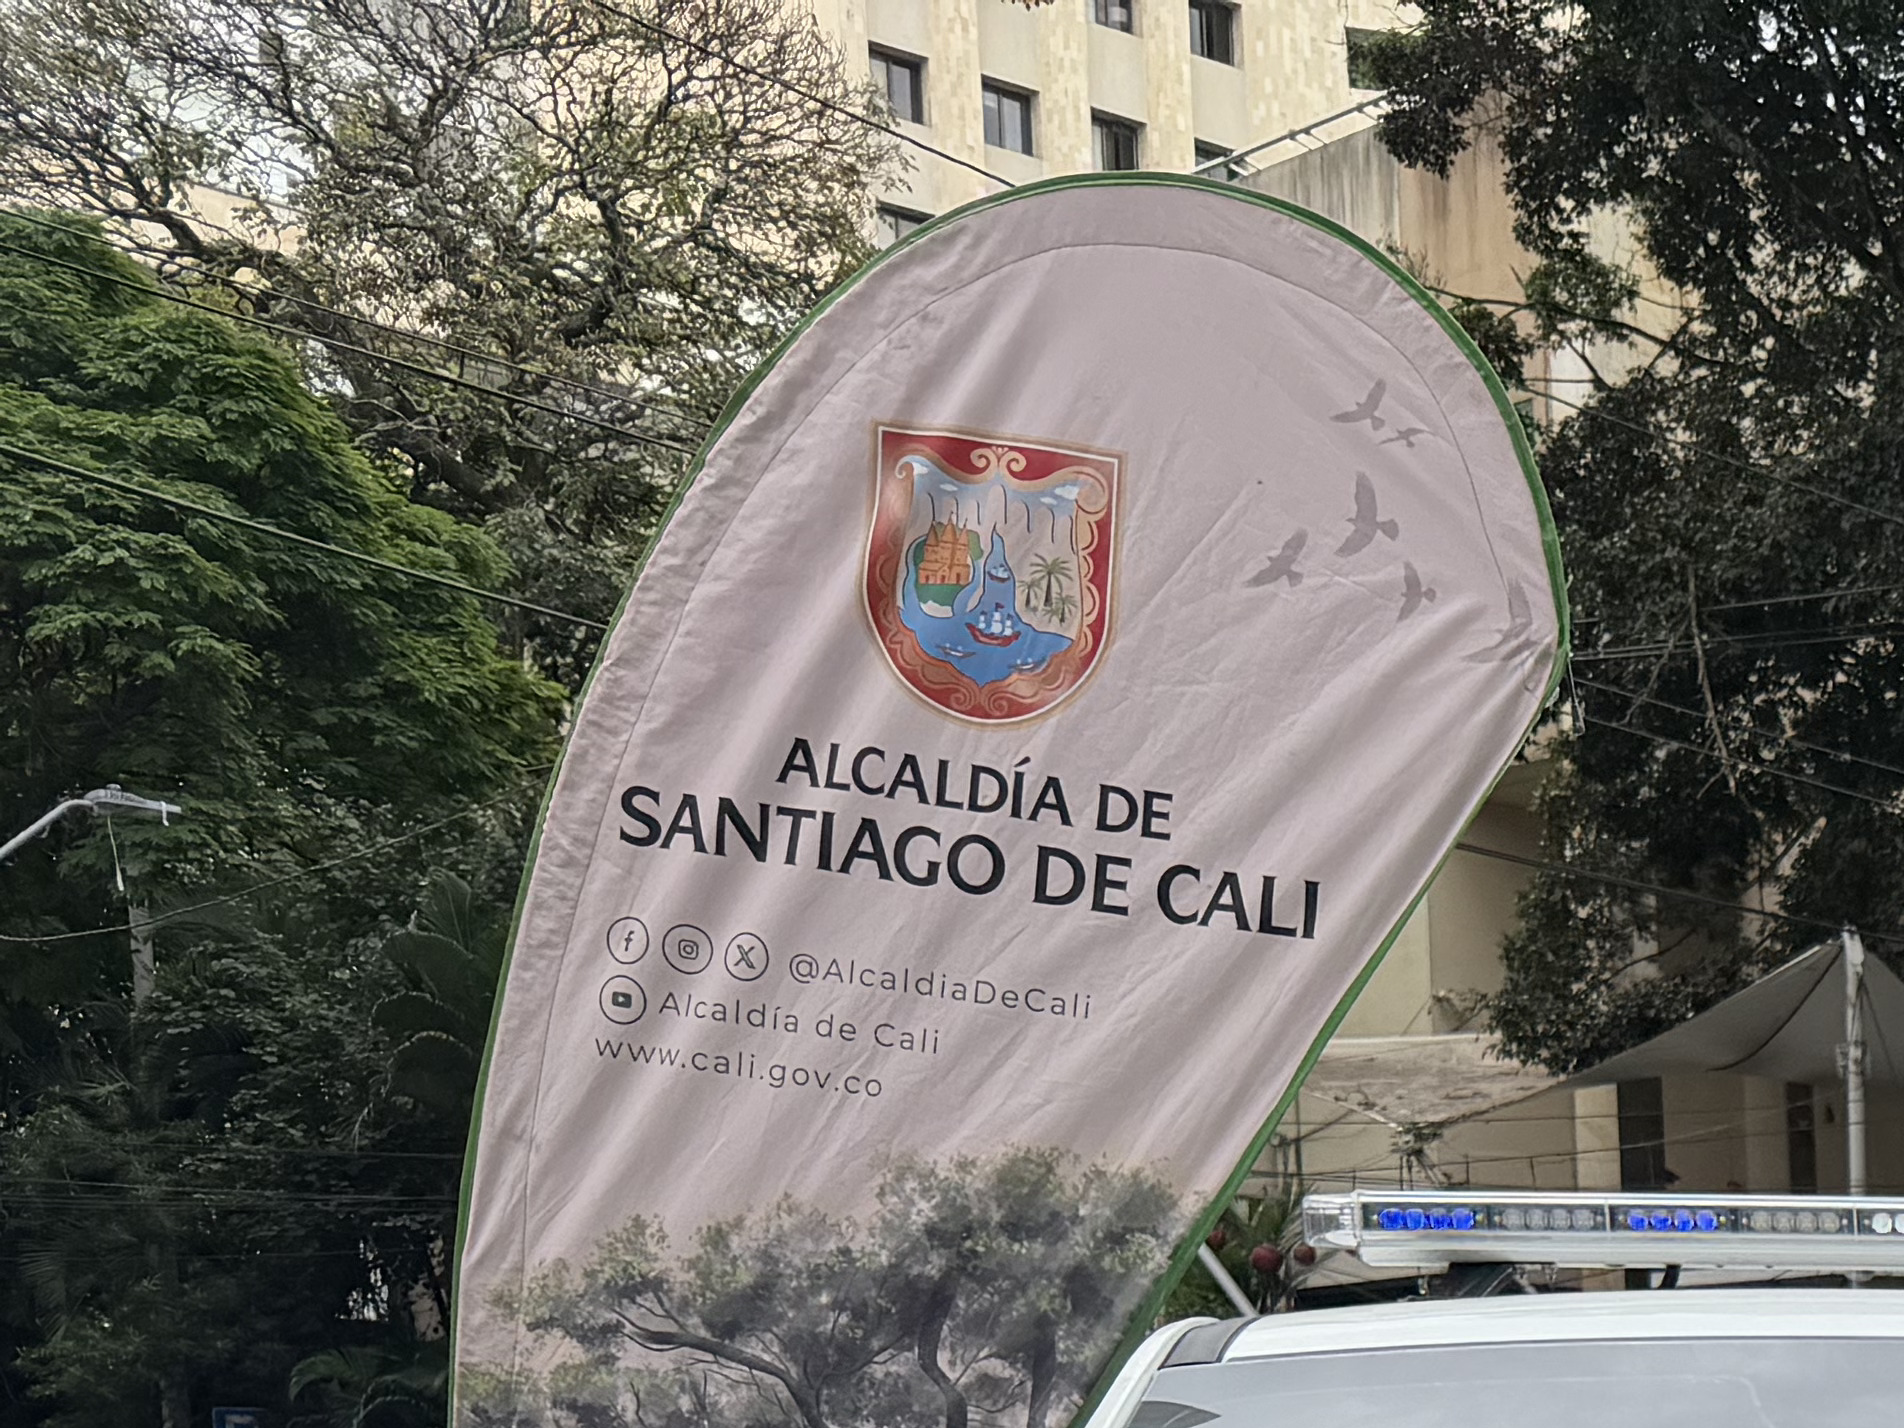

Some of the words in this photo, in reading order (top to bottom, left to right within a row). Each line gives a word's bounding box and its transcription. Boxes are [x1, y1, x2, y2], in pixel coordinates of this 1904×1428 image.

[776, 737, 1074, 827] ALCALDÍA
[1096, 786, 1174, 841] DE
[619, 786, 1006, 897] SANTIAGO
[1033, 846, 1133, 916] DE
[1156, 865, 1322, 940] CALI
[789, 953, 1092, 1020] @AlcaldiaDeCali
[658, 990, 801, 1036] Alcaldía
[815, 1009, 858, 1044] de
[873, 1023, 941, 1055] Cali
[594, 1036, 883, 1098] www.cali.gov.co
